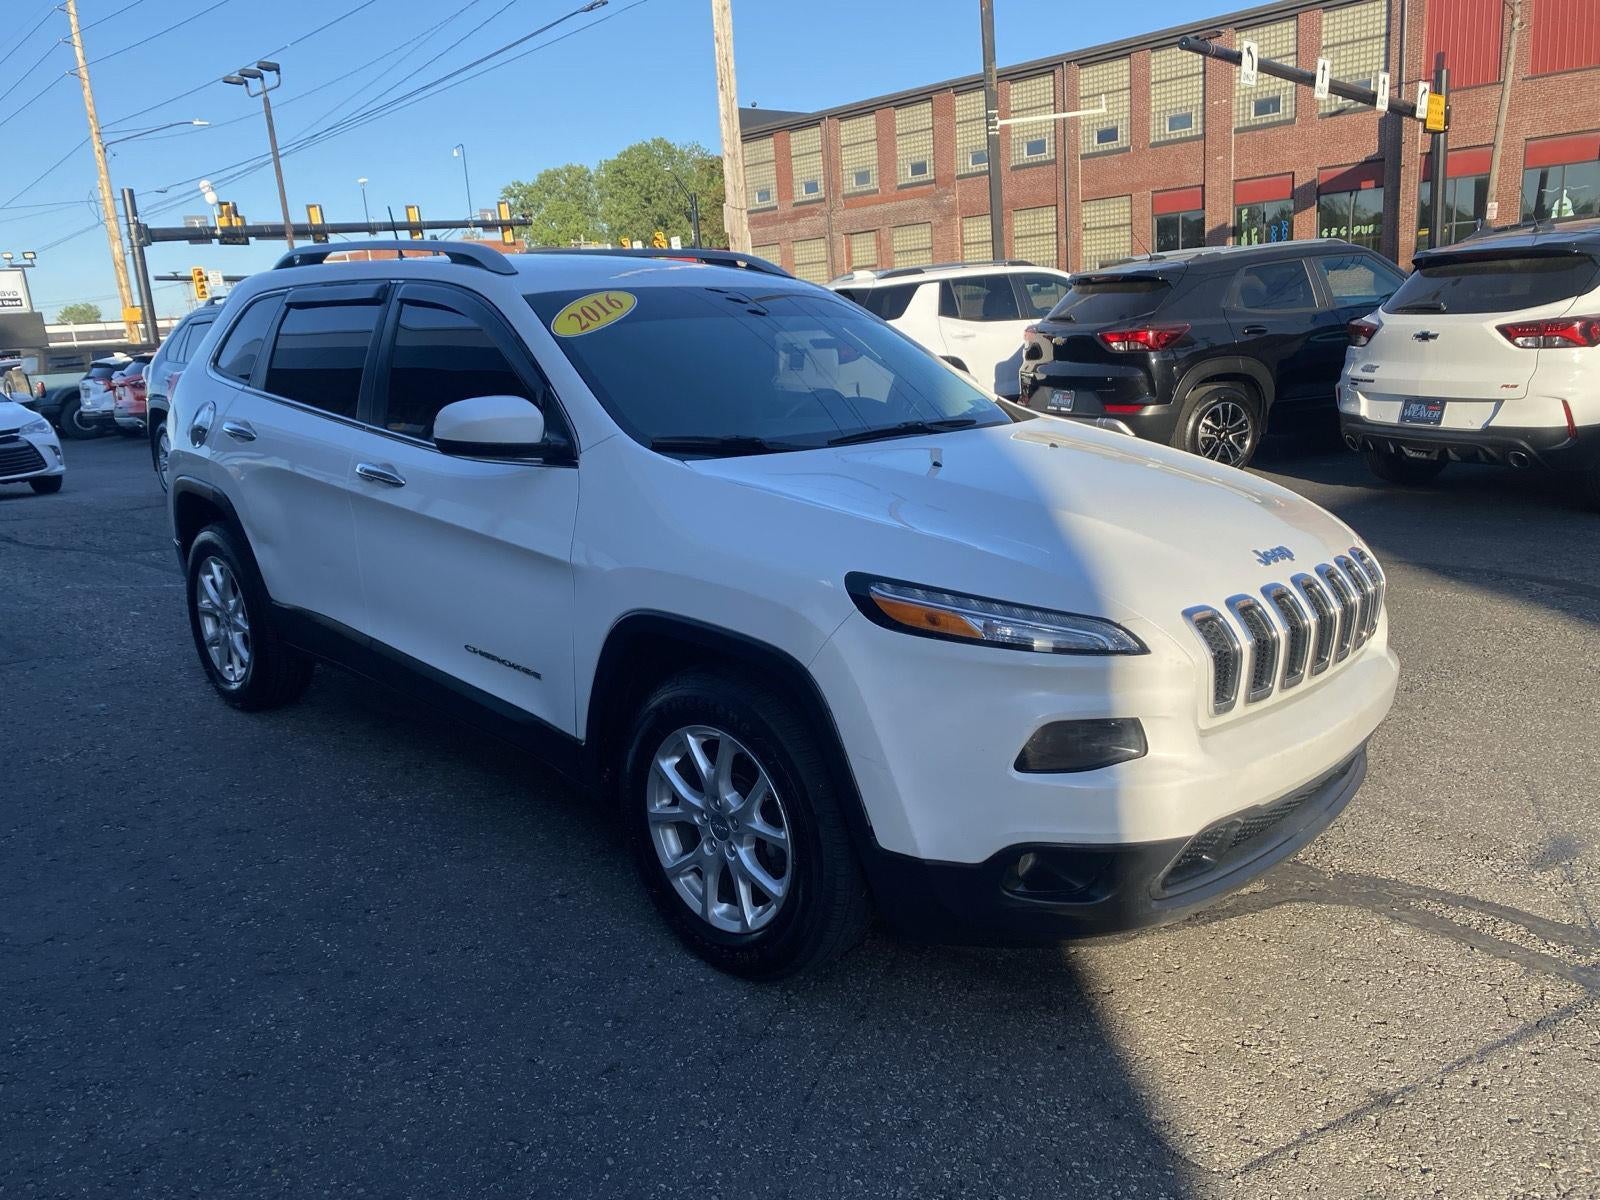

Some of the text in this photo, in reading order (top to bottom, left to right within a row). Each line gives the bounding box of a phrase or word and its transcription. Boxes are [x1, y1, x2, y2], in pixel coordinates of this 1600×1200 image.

[567, 293, 624, 331] 2016
[1404, 408, 1441, 419] WEAVER
[1251, 545, 1296, 567] Jeep
[464, 644, 542, 681] CHEROKEE
